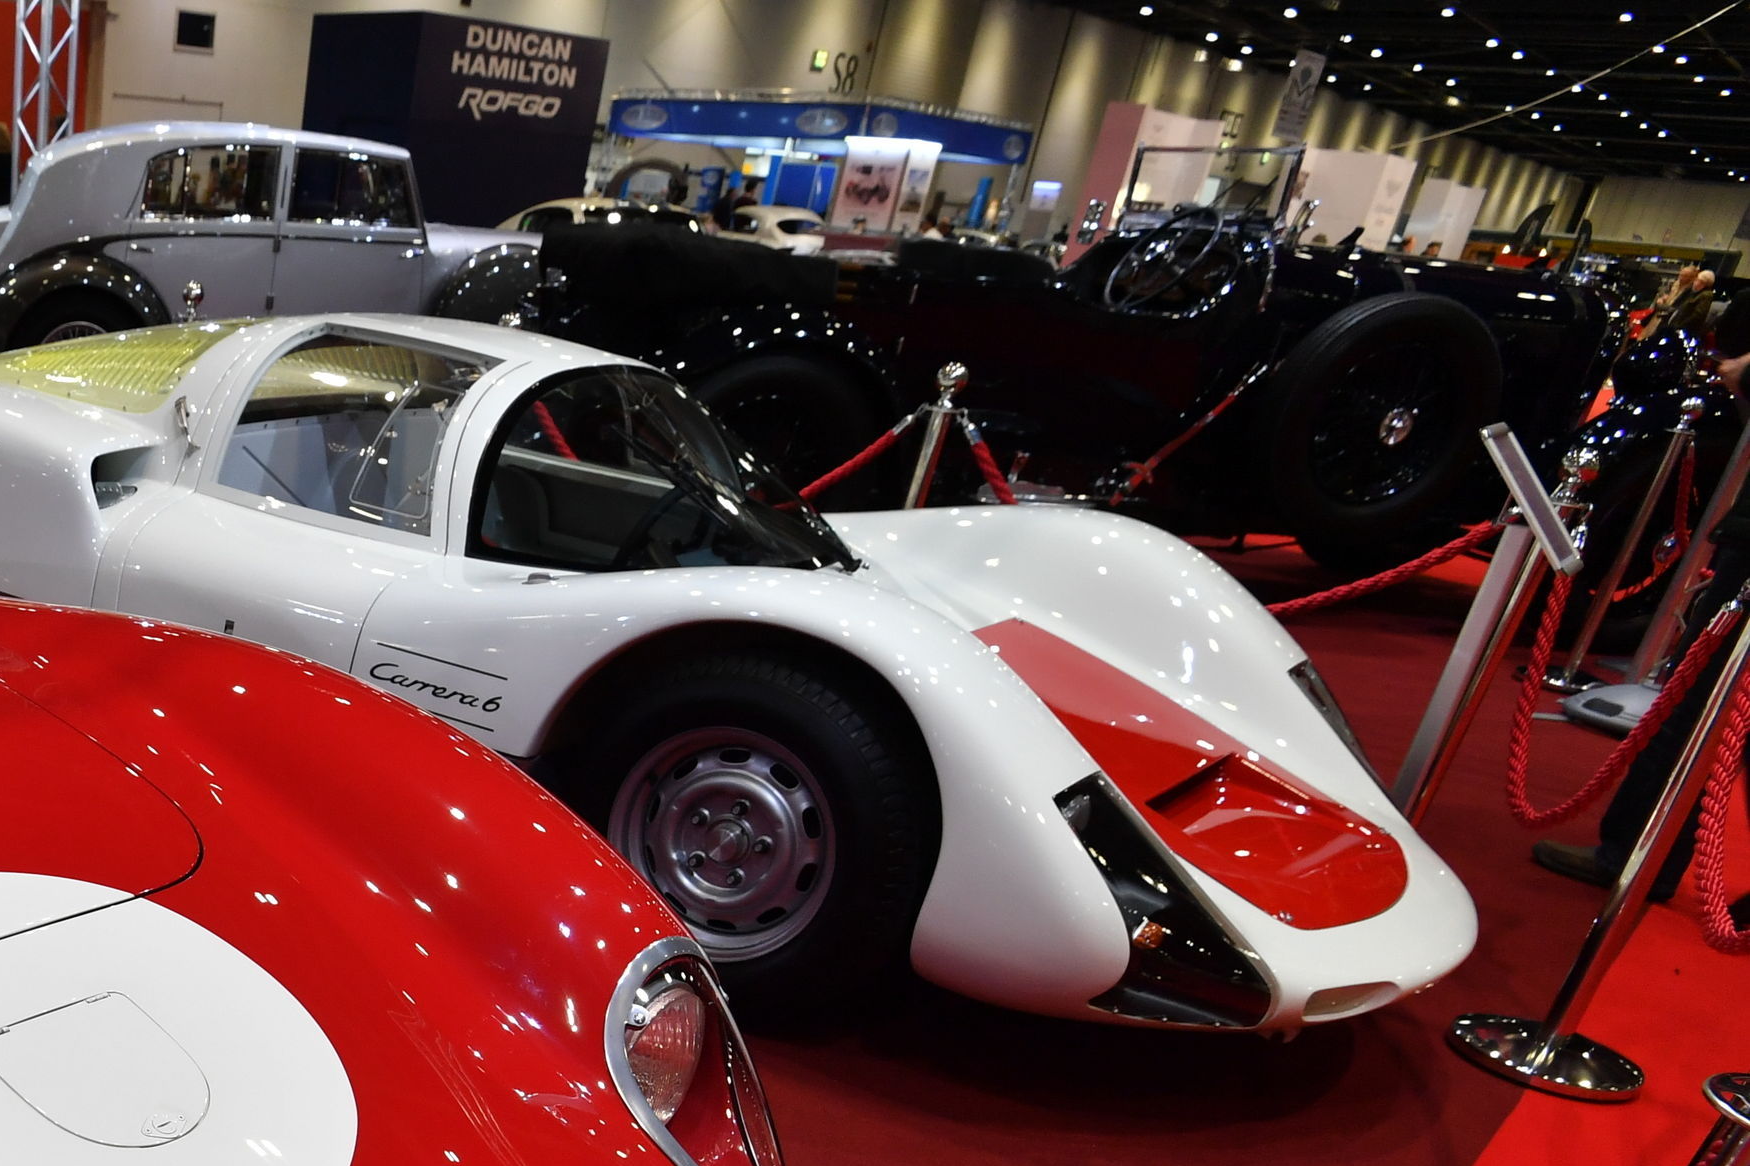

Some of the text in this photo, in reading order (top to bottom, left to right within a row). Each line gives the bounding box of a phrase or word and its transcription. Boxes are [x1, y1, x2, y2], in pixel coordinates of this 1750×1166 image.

[466, 24, 572, 62] DUNCAN
[450, 50, 577, 89] HAMILTON
[457, 86, 562, 121] ROFGO
